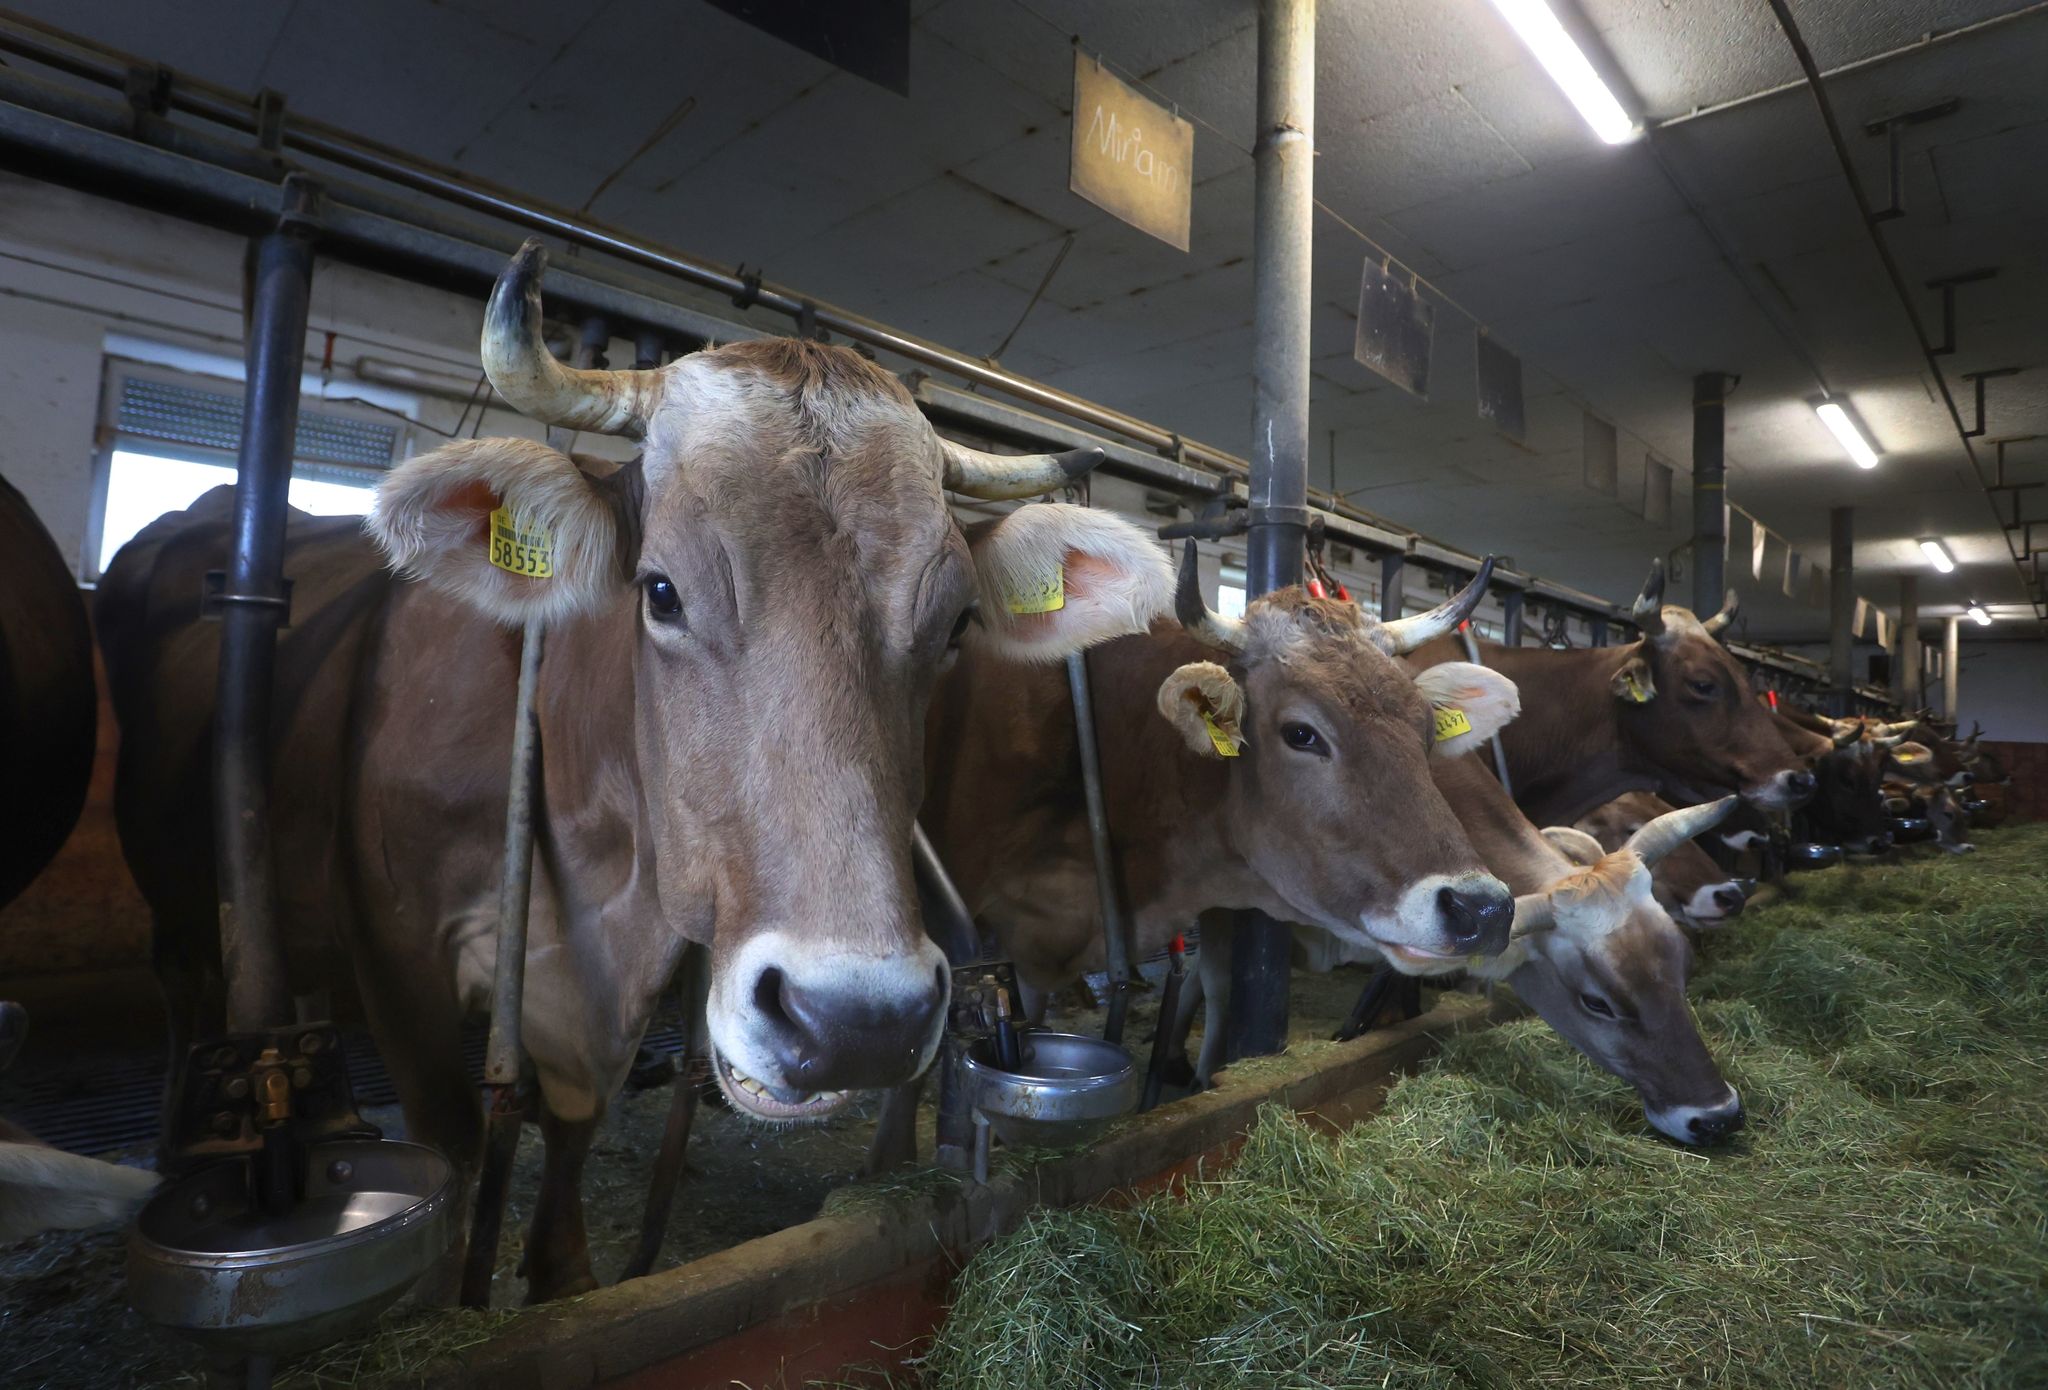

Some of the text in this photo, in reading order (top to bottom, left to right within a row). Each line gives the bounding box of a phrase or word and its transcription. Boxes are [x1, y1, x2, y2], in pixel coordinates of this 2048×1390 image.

[1086, 104, 1178, 194] Miriam
[494, 537, 550, 575] 58553
[1436, 712, 1465, 735] 1497
